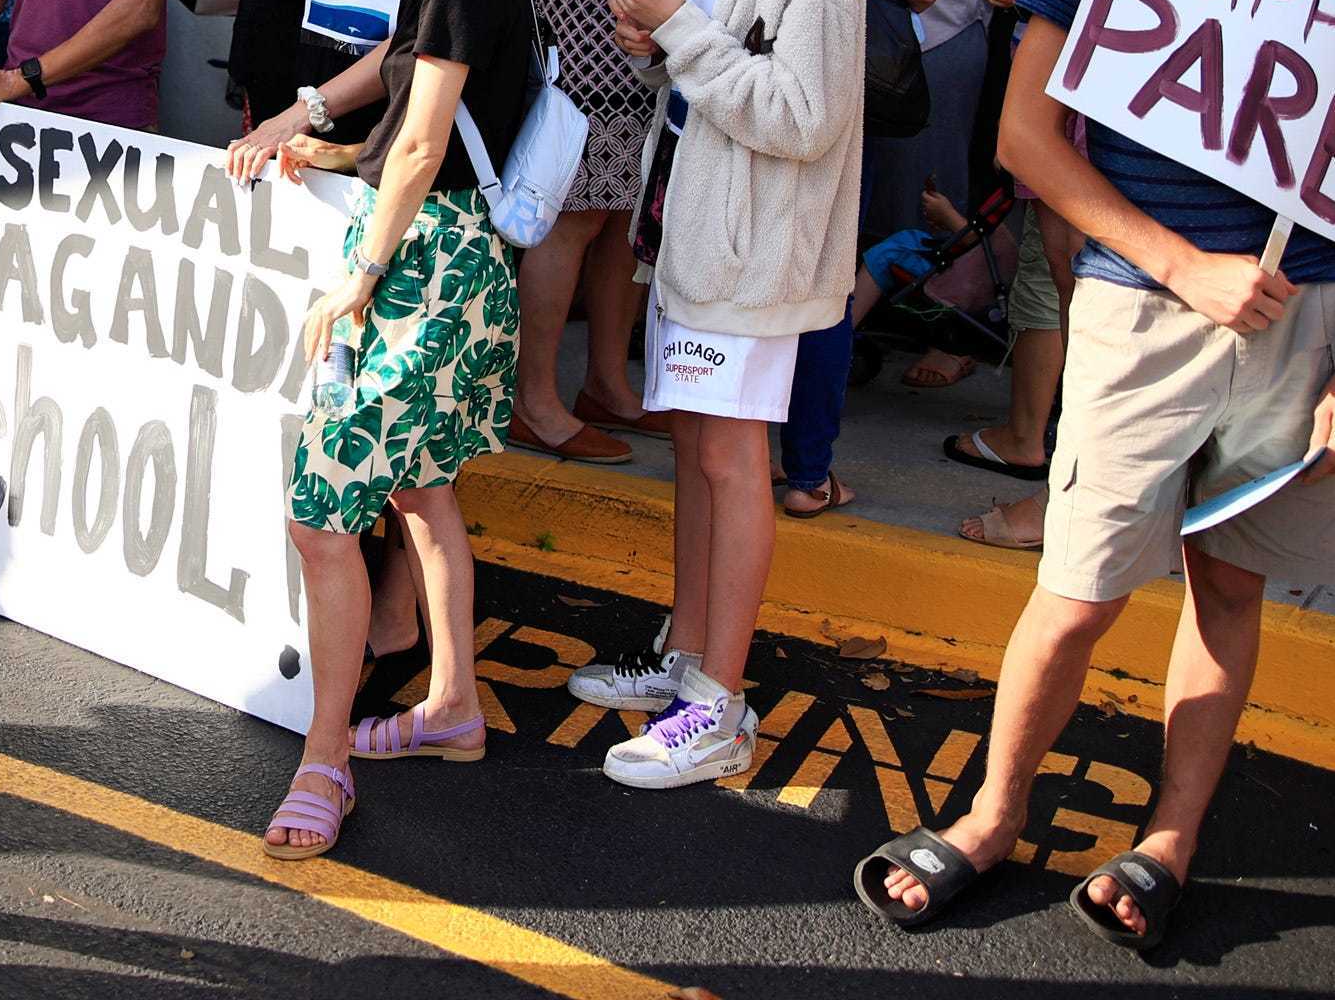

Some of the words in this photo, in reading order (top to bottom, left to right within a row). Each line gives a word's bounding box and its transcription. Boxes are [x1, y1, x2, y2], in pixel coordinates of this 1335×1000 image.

[663, 340, 726, 367] CHICAGO
[665, 363, 715, 376] SUPERSPORT
[674, 373, 700, 384] STATE
